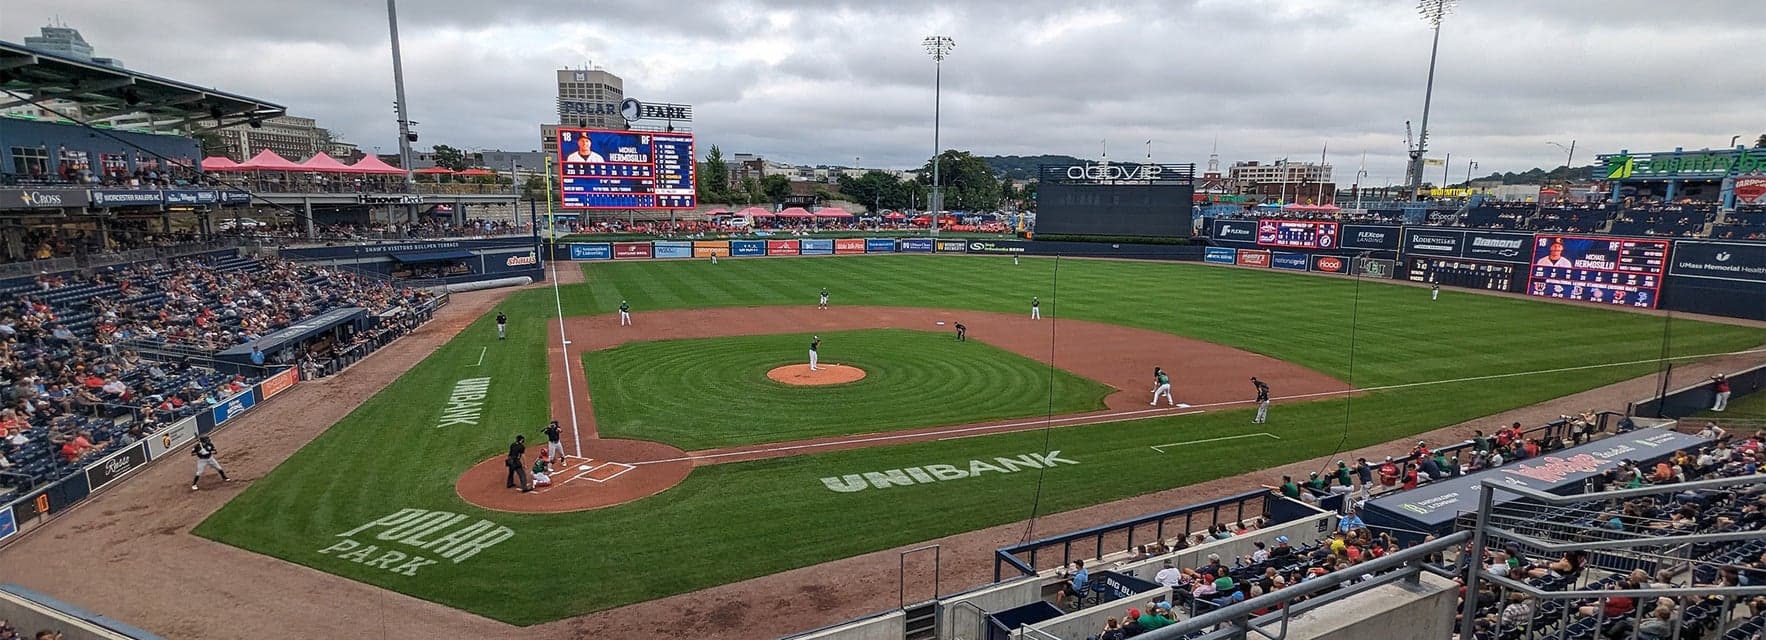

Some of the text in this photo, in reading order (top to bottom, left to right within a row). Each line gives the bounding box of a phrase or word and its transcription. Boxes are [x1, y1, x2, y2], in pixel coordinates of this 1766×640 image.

[566, 101, 686, 119] POLAR PARK
[562, 132, 572, 142] 18
[1319, 260, 1339, 269] Hood
[1574, 259, 1615, 270] HERMOSILLO
[1704, 263, 1740, 272] Memorial
[820, 450, 1080, 493] UNIBANK
[335, 508, 515, 564] POLAR
[317, 539, 439, 577] PARK
